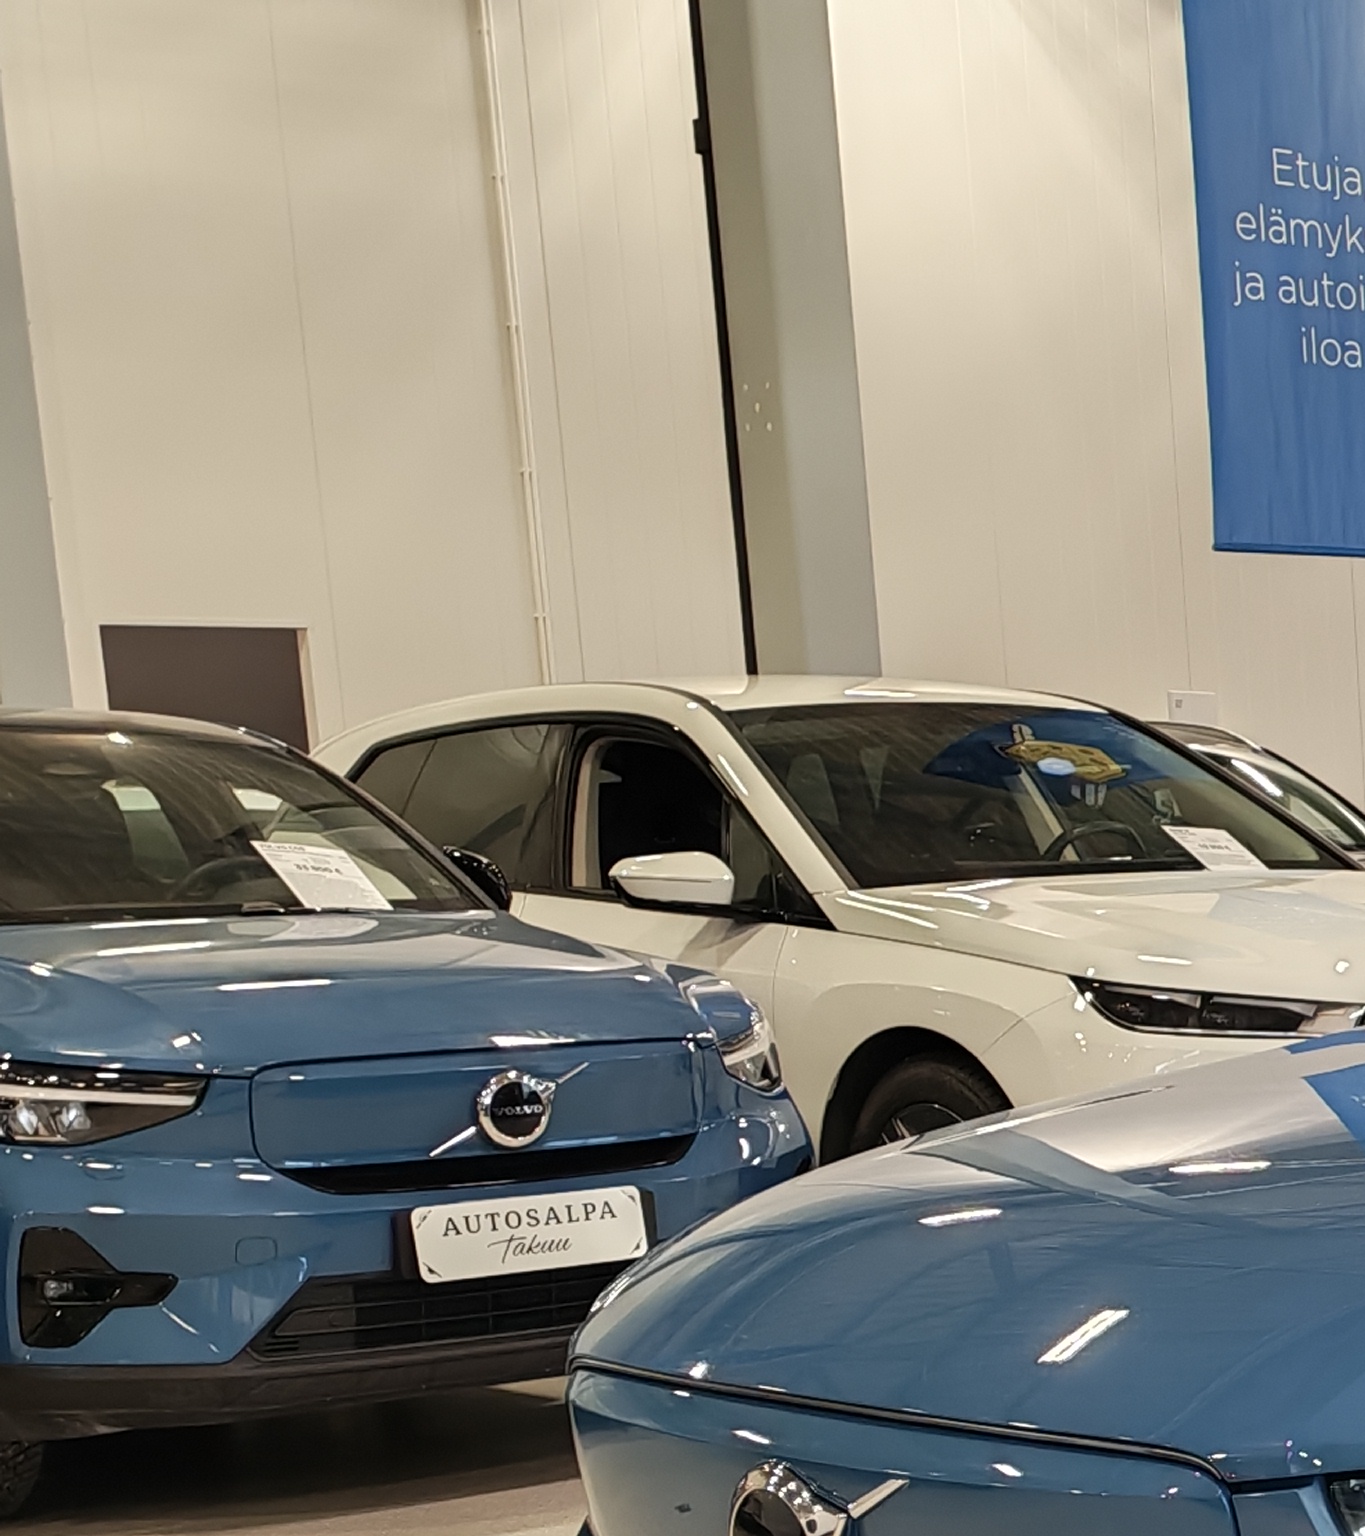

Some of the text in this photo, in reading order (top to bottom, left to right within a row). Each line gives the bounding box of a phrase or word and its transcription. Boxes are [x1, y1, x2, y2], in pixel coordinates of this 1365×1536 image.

[1233, 261, 1266, 307] ja
[1301, 326, 1363, 369] iloa
[442, 1199, 618, 1238] AUTOSALPA
[487, 1233, 573, 1266] Takuu
